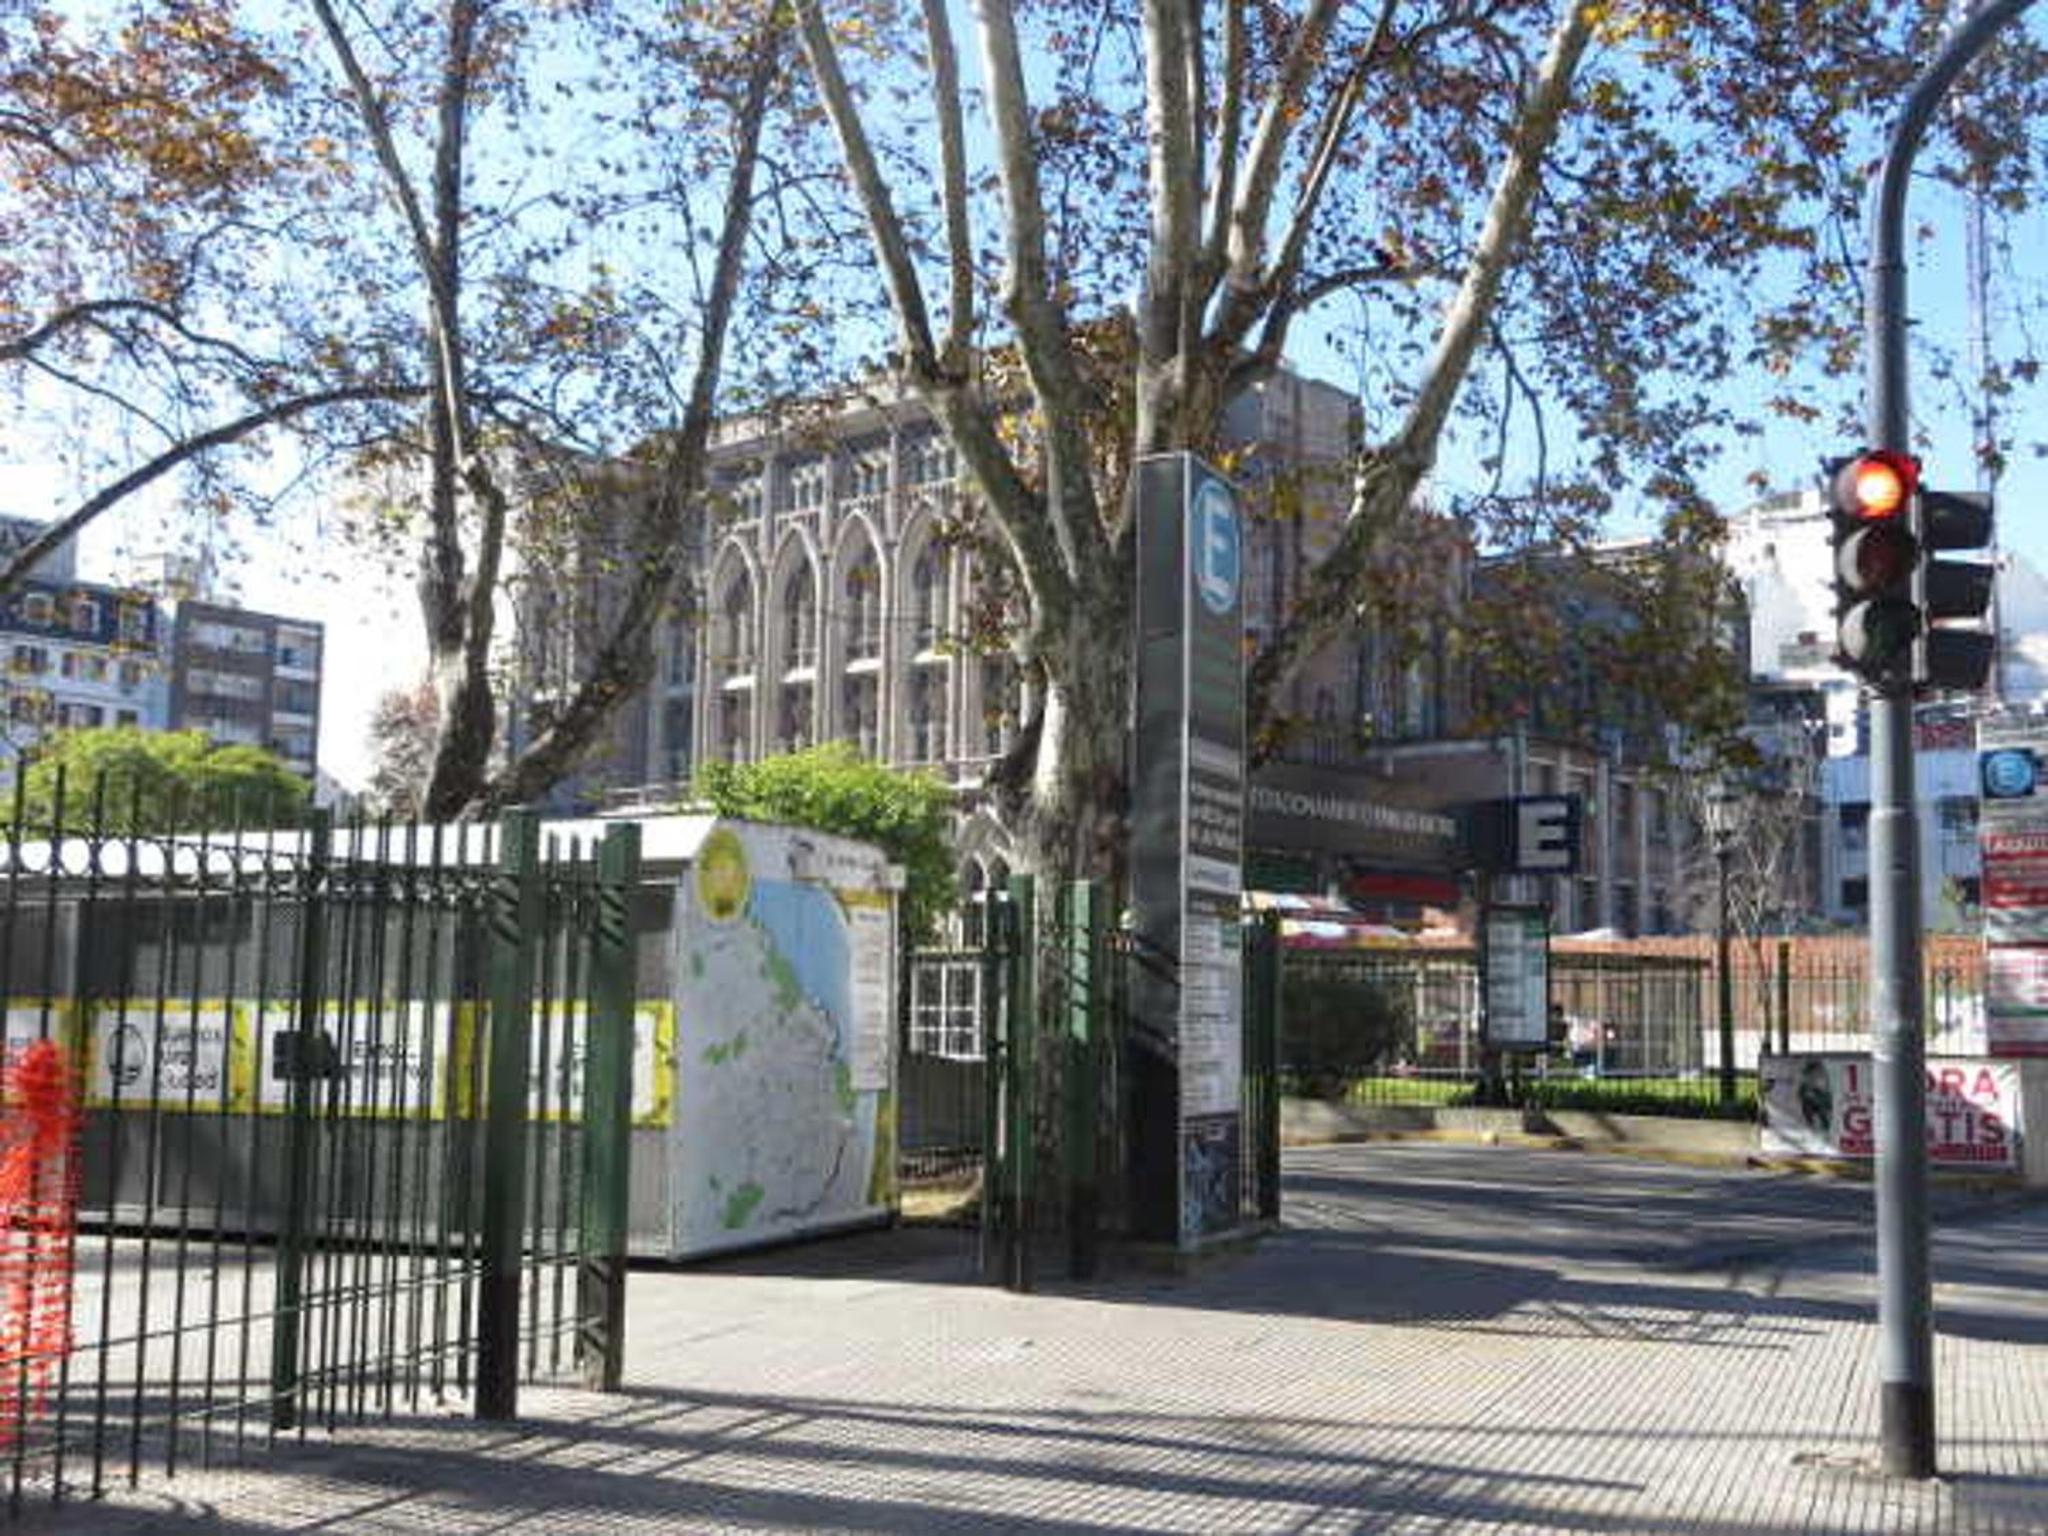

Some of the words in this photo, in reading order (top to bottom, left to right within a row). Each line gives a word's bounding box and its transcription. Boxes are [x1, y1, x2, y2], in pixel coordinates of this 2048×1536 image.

[1203, 492, 1232, 597] E
[1517, 801, 1571, 869] E
[1843, 1106, 2004, 1144] GTIS
